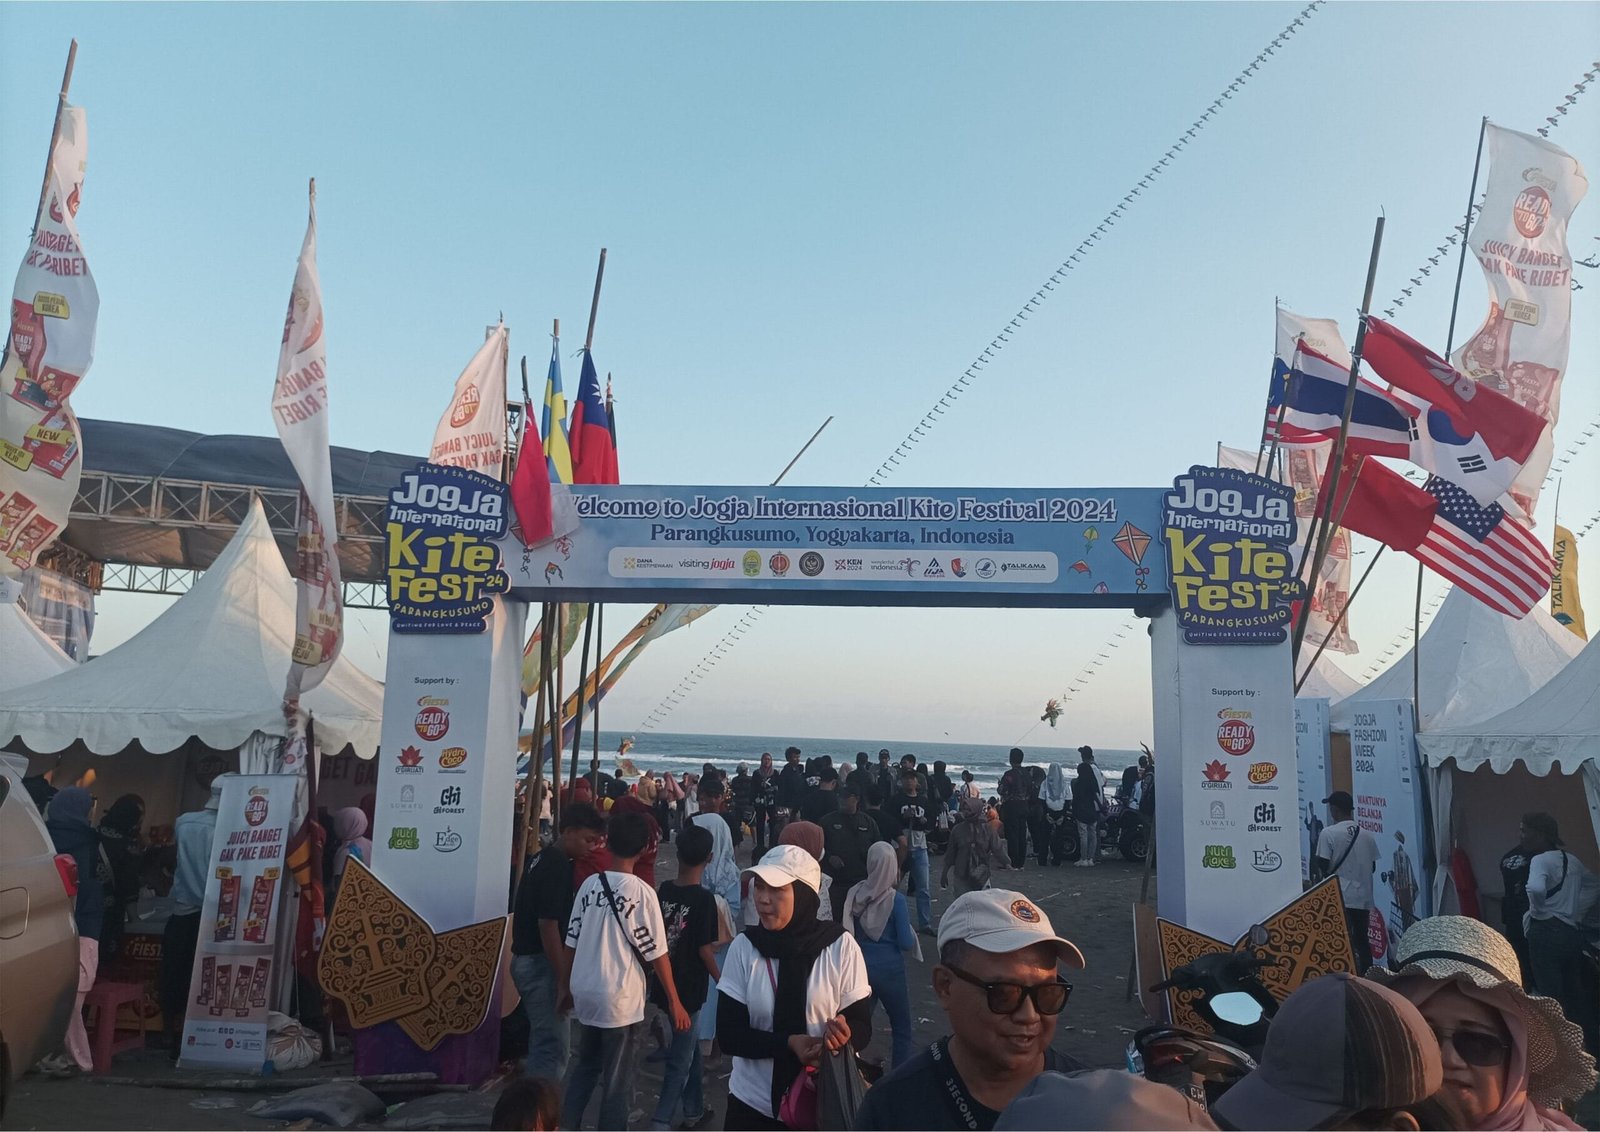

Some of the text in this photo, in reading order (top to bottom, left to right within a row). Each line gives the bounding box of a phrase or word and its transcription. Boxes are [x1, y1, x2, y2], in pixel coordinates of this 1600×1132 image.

[1481, 239, 1563, 268] JUICY BANGET
[1529, 269, 1570, 287] RIBET
[37, 428, 61, 441] NEW
[1194, 469, 1215, 477] The
[1247, 477, 1290, 498] Annual
[664, 499, 685, 518] to
[690, 497, 751, 522] Jogja
[755, 497, 906, 519] Internasional
[909, 498, 954, 520] Kite
[959, 498, 1047, 520] Festival
[1051, 499, 1116, 520] 2024
[390, 505, 503, 532] International
[1167, 510, 1291, 538] International
[651, 523, 1015, 547] Parangkusumo, Yogyakarta, Indonesia
[386, 522, 495, 573] Kite
[1165, 527, 1287, 580] Kite
[679, 557, 736, 570] visiting jogja
[1551, 540, 1566, 608] TALIKAMA
[388, 568, 486, 603] Fest
[1173, 575, 1280, 611] Fest
[393, 602, 489, 618] PARANGKUSUMO
[1183, 611, 1287, 628] PARANGKUSUMO
[414, 677, 444, 685] Support
[446, 677, 455, 685] by
[1212, 688, 1243, 697] Support
[1245, 688, 1255, 697] by
[416, 712, 448, 724] READY
[1354, 714, 1376, 726] JOGJA
[427, 724, 440, 736] GO
[1218, 726, 1253, 738] READY
[1355, 729, 1387, 742] FASHION
[1231, 738, 1245, 750] GO
[1355, 745, 1376, 758] WEEK
[442, 749, 466, 757] Hydro
[441, 756, 462, 766] Coco
[1250, 764, 1276, 773] Hydro
[1355, 760, 1374, 773] 2024
[1250, 771, 1272, 783] Coco
[441, 786, 461, 805] Chi
[246, 802, 268, 812] READY
[1254, 802, 1275, 823] Chi
[227, 828, 282, 845] JUICY BANGET
[219, 845, 282, 862] GAK PAKE RIBET
[1252, 851, 1279, 866] Edge
[132, 943, 164, 957] FIEST
[946, 1078, 978, 1130] 3SECOND
